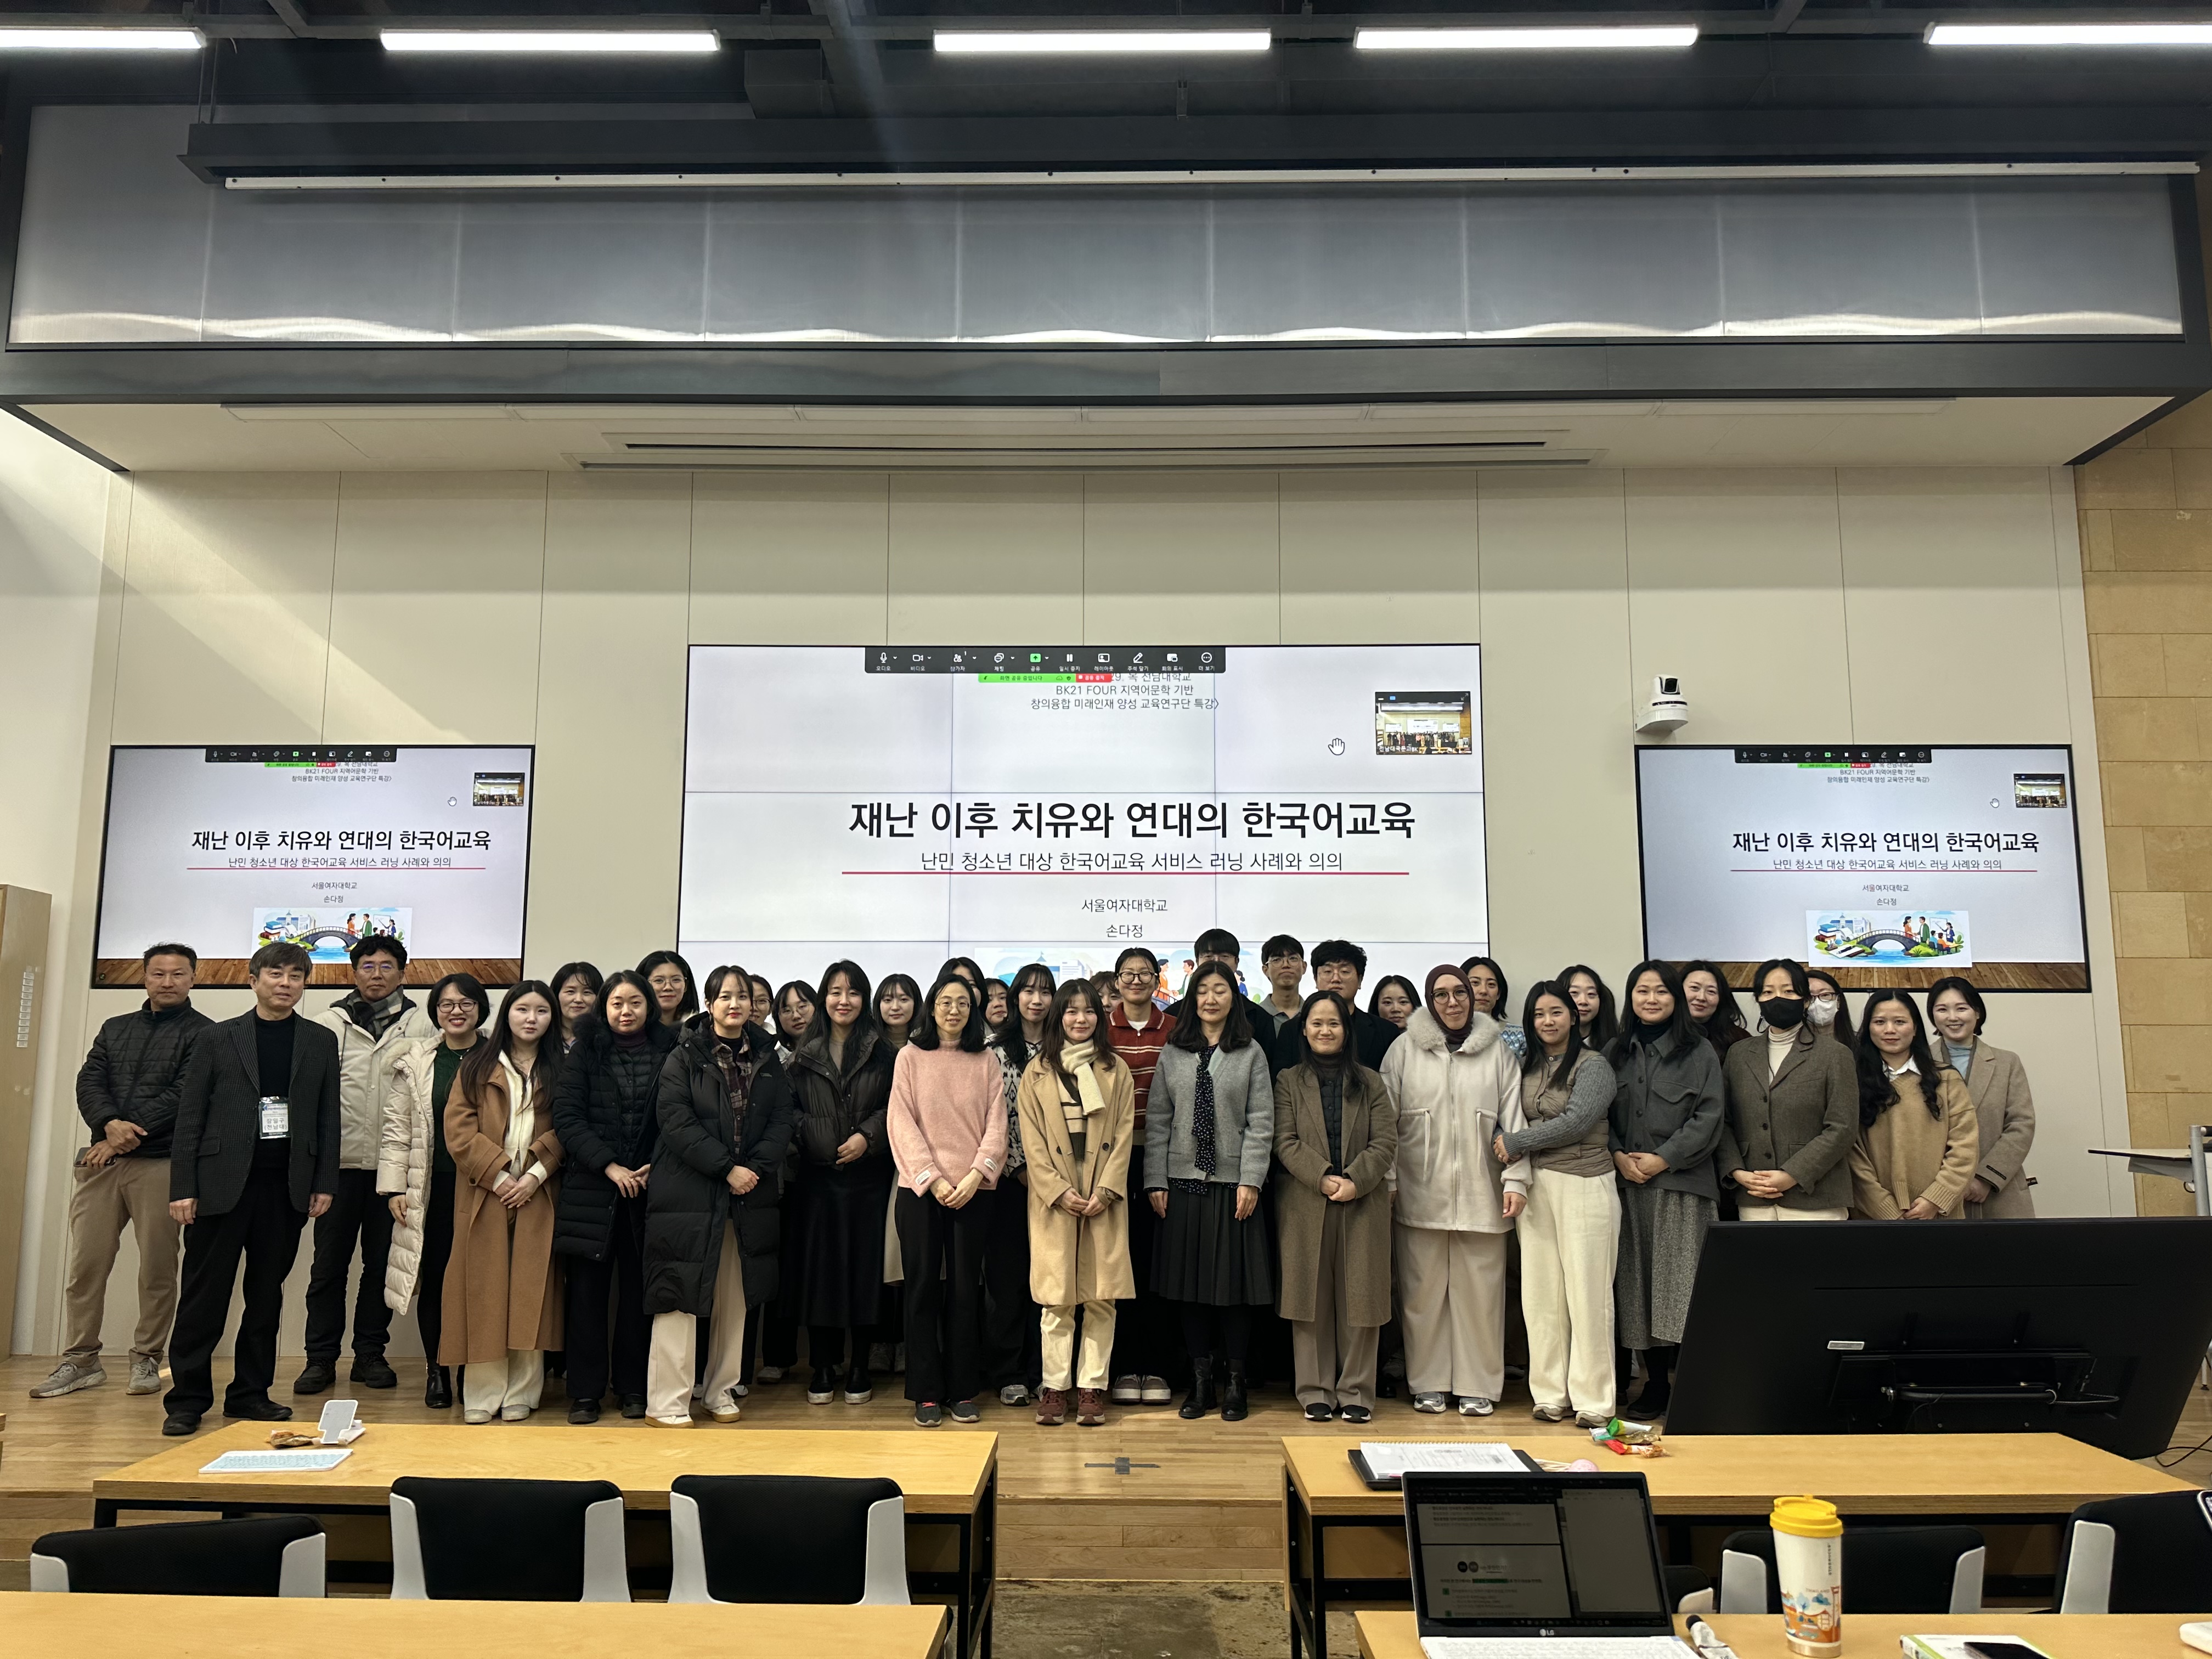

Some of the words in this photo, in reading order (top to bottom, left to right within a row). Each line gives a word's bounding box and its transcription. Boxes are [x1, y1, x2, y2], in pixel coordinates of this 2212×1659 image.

[1142, 673, 1192, 682] 전남대학교
[1056, 685, 1081, 695] BK21
[1087, 685, 1116, 695] FOUR
[1120, 685, 1171, 696] 지역어문학
[1174, 685, 1194, 696] 기반
[1031, 698, 1071, 710] 창의융합
[1074, 698, 1114, 709] 미래인재
[1117, 698, 1137, 710] 양성
[1141, 698, 1191, 709] 교육연구단
[849, 802, 918, 838] 재난
[932, 802, 997, 838] 이후
[1011, 802, 1114, 838] 치유와
[1127, 802, 1227, 838] 연대의
[1242, 802, 1415, 839] 한국어교육
[191, 831, 229, 850] 재난
[235, 831, 270, 850] 이후
[277, 831, 332, 850] 치유와
[338, 831, 392, 850] 연대의
[399, 831, 491, 850] 한국어교육
[1733, 832, 1770, 852] 재난
[1777, 832, 1814, 853] 이후
[1821, 832, 1877, 853] 치유와
[1883, 832, 1939, 853] 연대의
[1945, 832, 2039, 853] 한국어교육
[229, 857, 246, 868] 난민
[250, 857, 276, 868] 청소년
[280, 857, 298, 868] 대상
[302, 857, 347, 868] 한국어교육
[349, 857, 377, 868] 서비스
[381, 857, 398, 868] 러닝
[402, 857, 430, 868] 사례와
[433, 857, 451, 868] 의의
[922, 853, 953, 871] 난민
[962, 853, 1011, 871] 청소년
[1020, 853, 1053, 871] 대상
[1060, 853, 1145, 871] 한국어교육
[1151, 853, 1203, 871] 서비스
[1210, 853, 1243, 871] 러닝
[1250, 853, 1302, 871] 사례와
[1309, 853, 1342, 871] 의의
[1773, 859, 1792, 870] 난민
[1795, 859, 1823, 870] 청소년
[1826, 859, 1845, 870] 대상
[1849, 859, 1895, 870] 한국어교육
[1898, 859, 1927, 870] 서비스
[1930, 859, 1948, 870] 러닝
[1951, 859, 1980, 870] 사례와
[1983, 859, 2001, 870] 의의
[311, 882, 357, 890] 서울여자대학교
[1862, 884, 1910, 892] 서울여자대학교
[324, 895, 343, 904] 손다정
[1081, 899, 1168, 913] 서울여자대학교
[1106, 924, 1143, 938] 손다정
